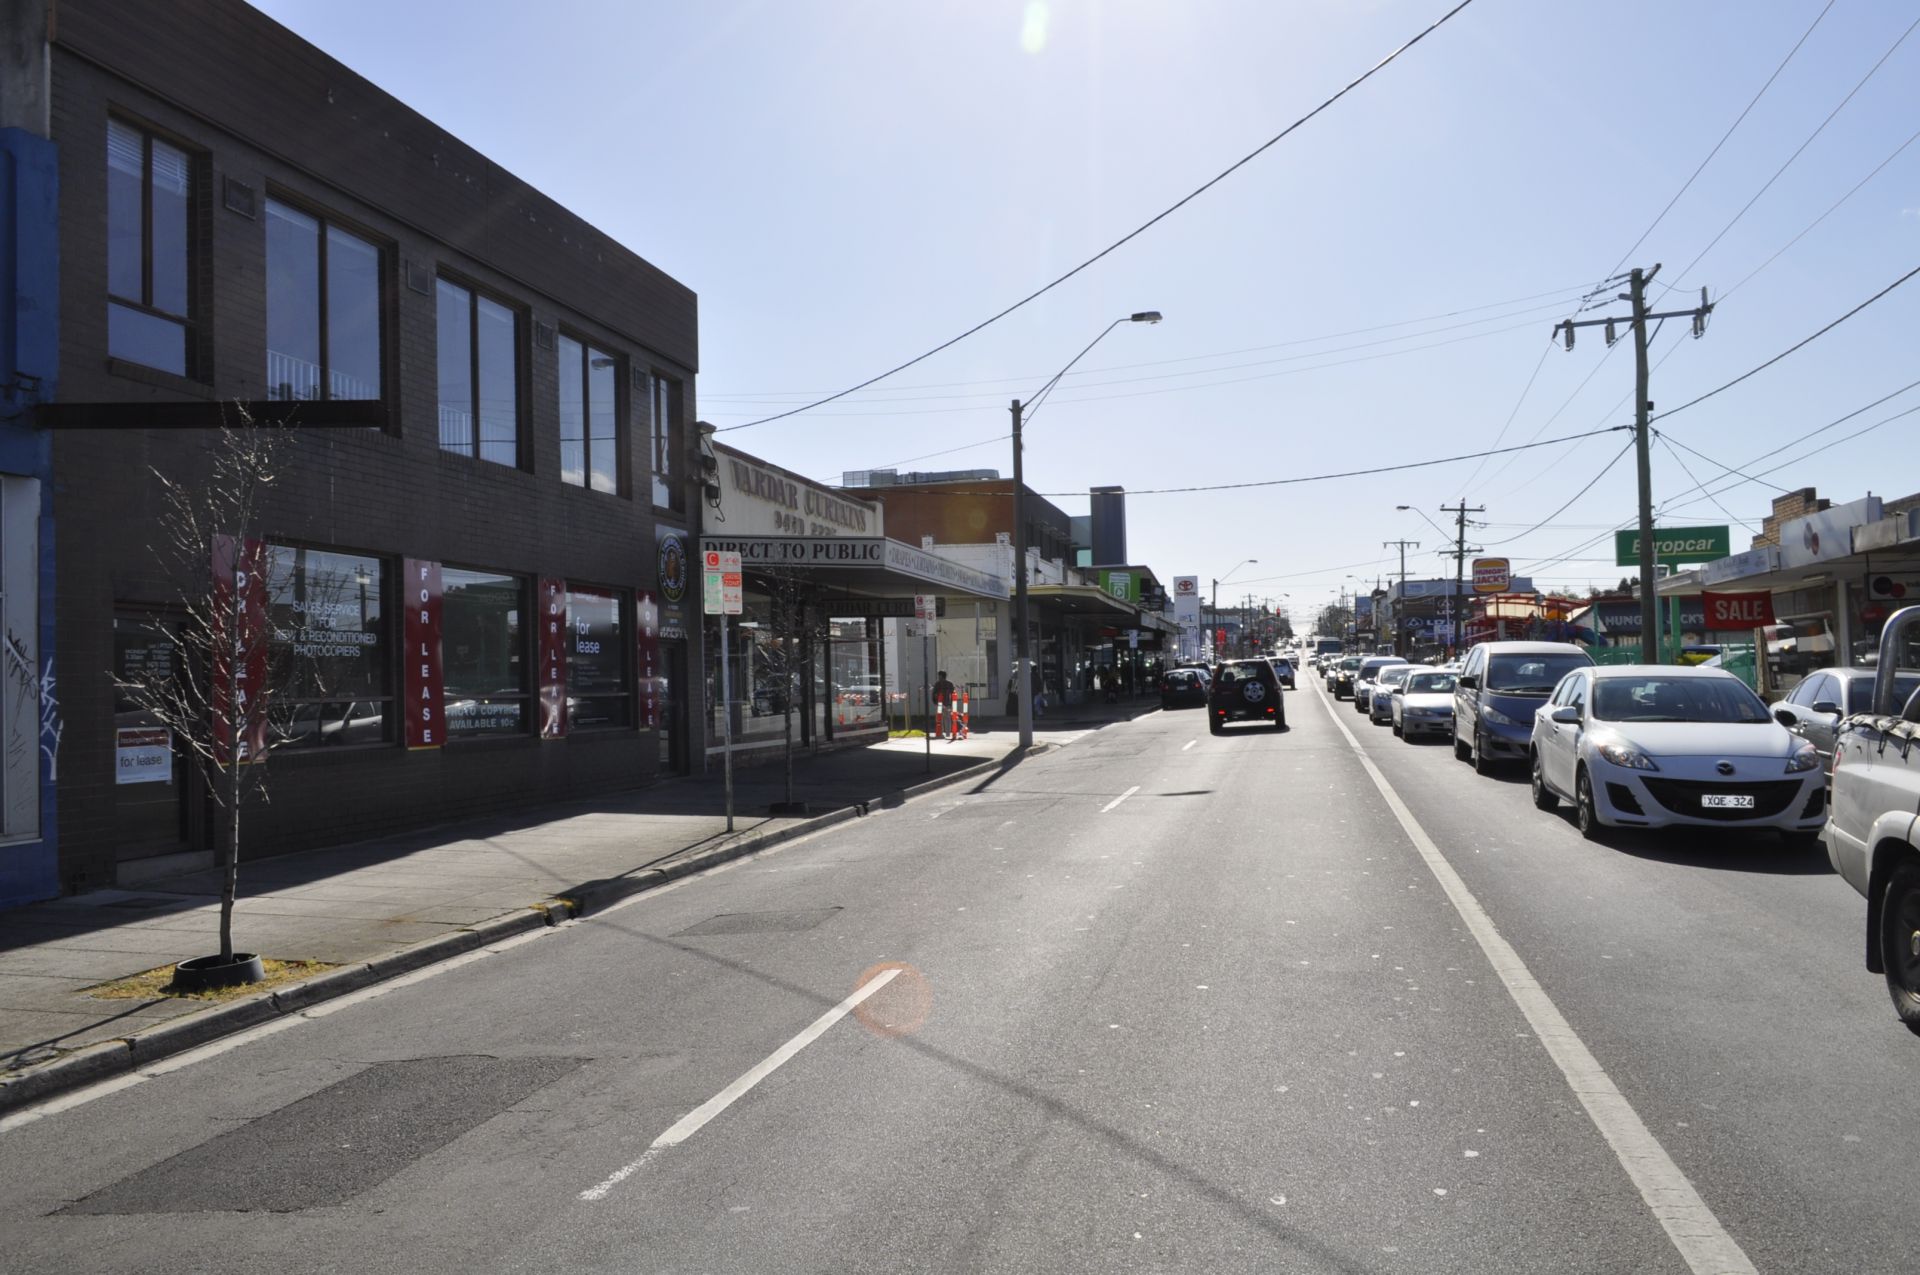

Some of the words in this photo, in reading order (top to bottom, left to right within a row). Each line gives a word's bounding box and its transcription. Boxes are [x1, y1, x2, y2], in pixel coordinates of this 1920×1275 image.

[730, 459, 799, 510] VARDAR
[804, 488, 867, 533] CURTAINS
[704, 541, 773, 560] DIRECT
[780, 543, 805, 559] TO
[813, 543, 880, 561] PUBLIC
[1632, 537, 1715, 554] Eropcar
[1474, 575, 1507, 584] JACK'S
[1475, 568, 1507, 576] HUNGRY
[420, 567, 430, 624] FOR
[292, 601, 321, 615] SALES
[325, 604, 360, 617] SERVICE
[550, 585, 558, 634] FOR
[644, 595, 652, 637] FOR
[1715, 599, 1763, 621] SALE
[319, 617, 337, 629] FOR
[576, 616, 591, 635] for
[1605, 615, 1643, 626] HUNG
[1665, 613, 1705, 624] JCK'S
[300, 631, 306, 642] &
[309, 630, 377, 645] RECONDITIONED
[576, 634, 601, 655] lease
[293, 644, 361, 657] PHOTOCOPIERS
[421, 643, 432, 743] LEASE
[551, 649, 559, 734] LEASE
[646, 651, 654, 725] LEASE
[449, 718, 497, 731] AVAILABLE
[120, 756, 134, 768] for
[136, 754, 162, 767] lease
[1733, 796, 1753, 807] 324
